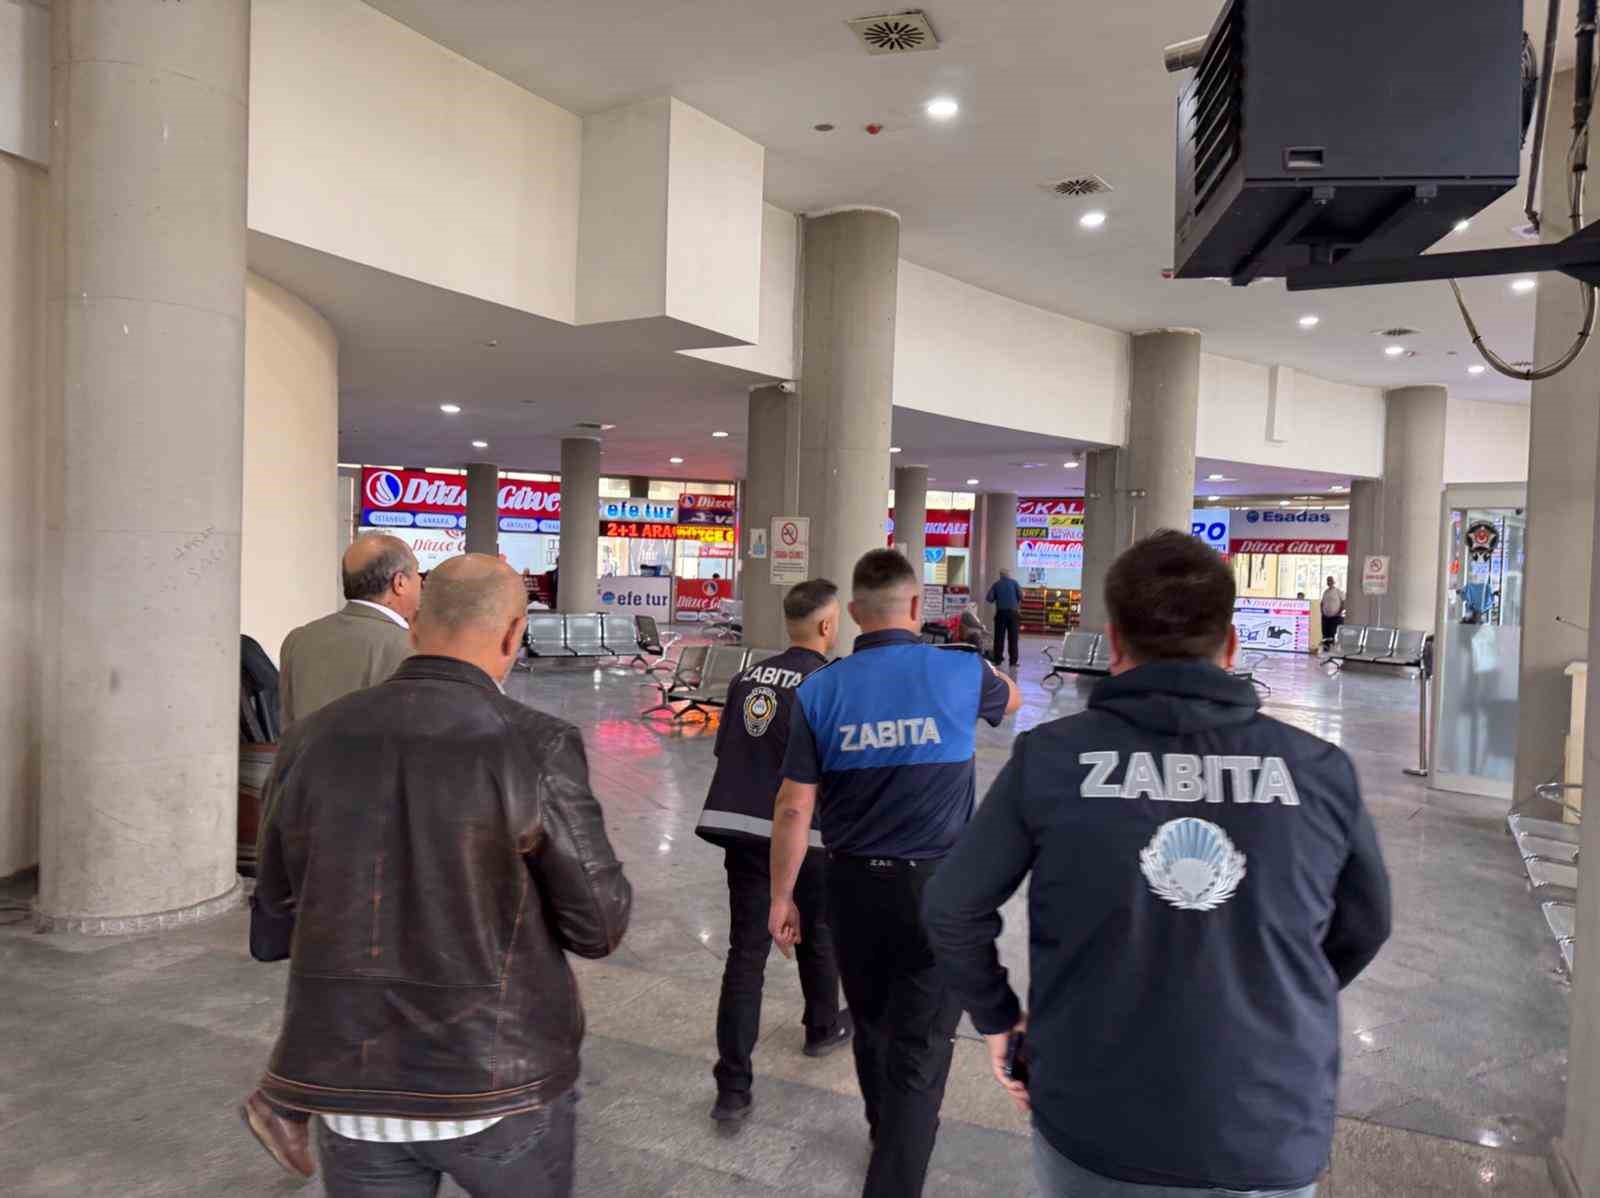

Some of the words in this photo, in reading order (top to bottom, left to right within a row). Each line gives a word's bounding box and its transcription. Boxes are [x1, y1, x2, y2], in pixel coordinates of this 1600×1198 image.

[497, 485, 561, 512] Güve
[606, 501, 640, 517] efe
[644, 503, 674, 519] tur
[1034, 503, 1086, 515] KAL
[606, 523, 640, 537] 2+1
[617, 590, 642, 606] efe
[646, 593, 668, 606] tur
[839, 716, 942, 752] ZABITA
[1078, 750, 1301, 806] ZABITA
